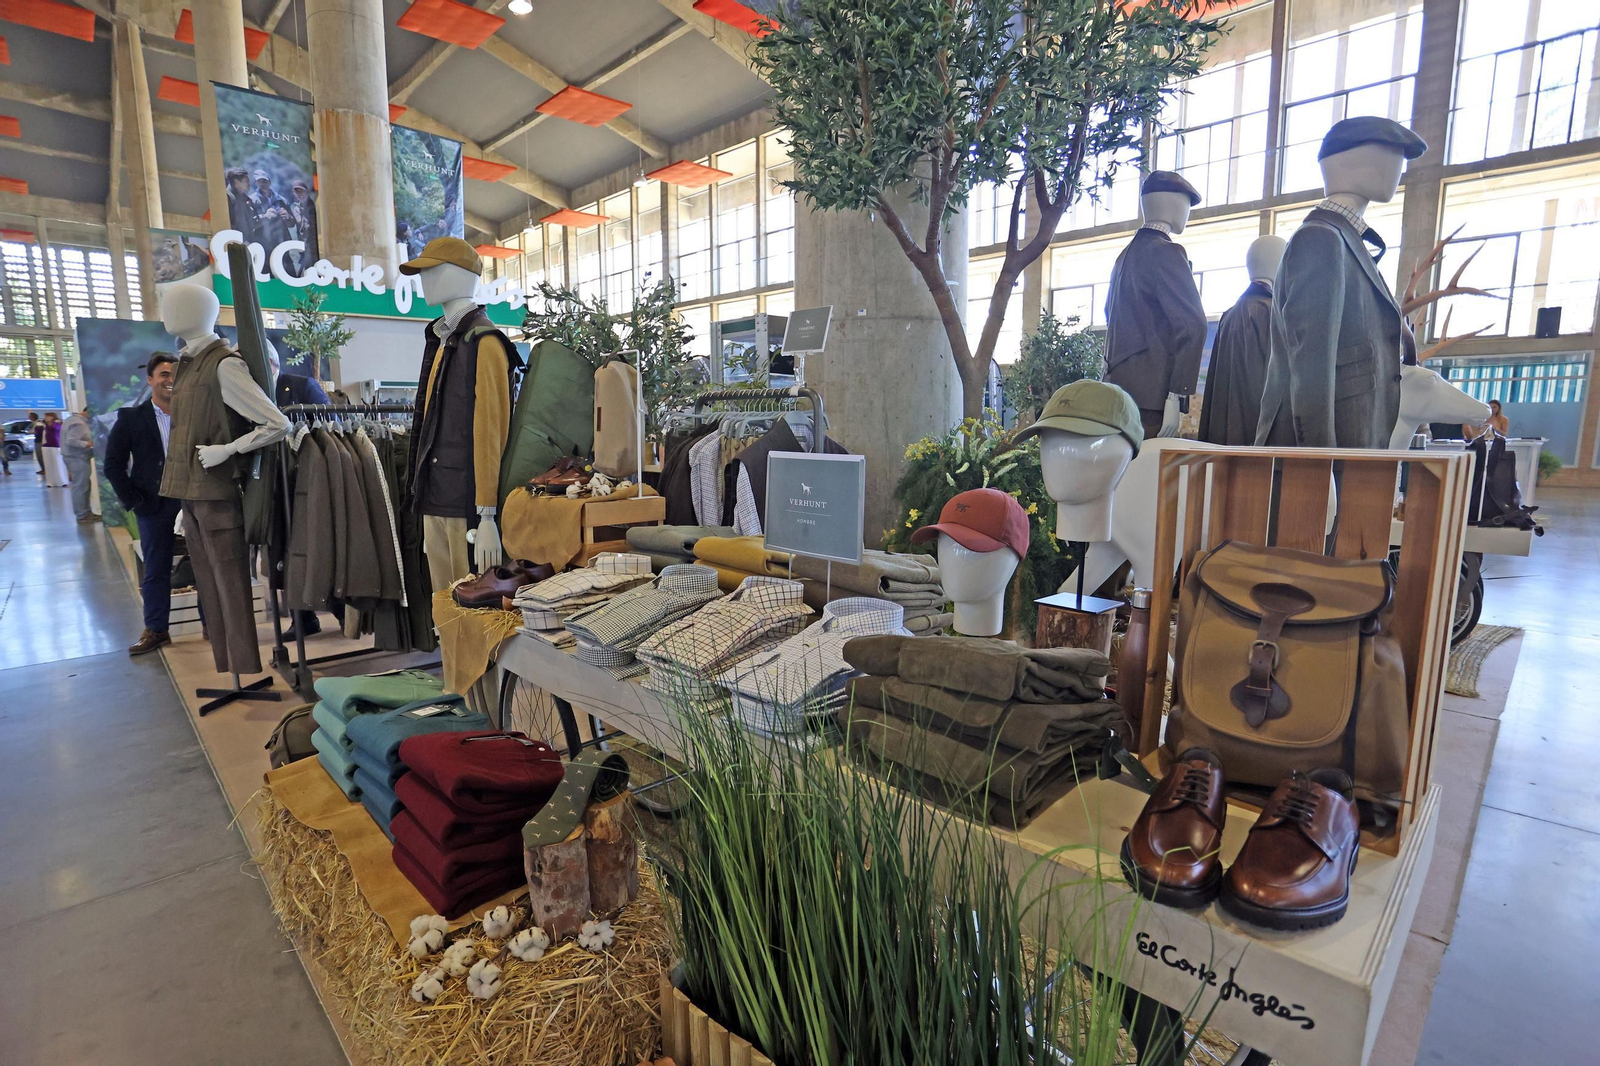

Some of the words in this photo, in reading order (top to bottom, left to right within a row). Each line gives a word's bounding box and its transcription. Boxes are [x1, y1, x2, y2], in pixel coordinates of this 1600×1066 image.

[231, 123, 300, 144] VERHUNT
[403, 159, 456, 177] VERHUNT
[269, 240, 386, 295] Corte
[789, 498, 827, 509] VERHUNT
[1135, 931, 1158, 960] El
[1160, 944, 1217, 987] Corte
[1219, 966, 1315, 1030] Inglés
